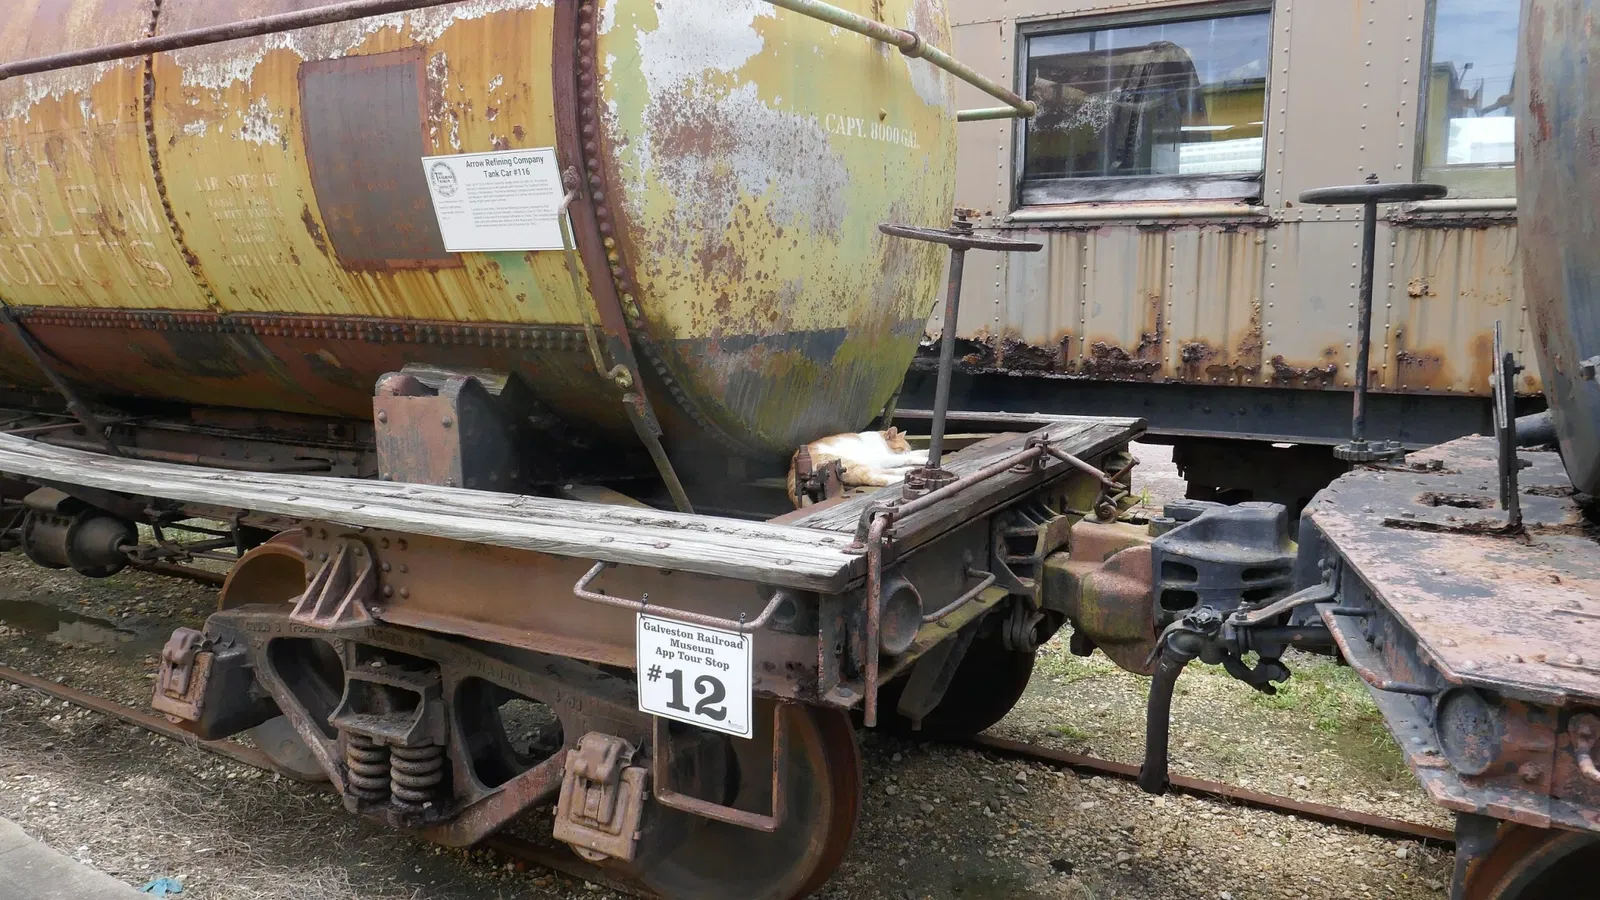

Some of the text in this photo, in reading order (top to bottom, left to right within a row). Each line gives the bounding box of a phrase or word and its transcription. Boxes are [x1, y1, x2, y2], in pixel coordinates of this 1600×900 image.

[870, 122, 900, 144] 8000
[465, 155, 544, 168] Arrow Refining Company
[483, 167, 531, 178] Tank Car #116
[643, 621, 744, 650] Galveston Railroad
[669, 638, 714, 655] Museum
[655, 646, 730, 672] App Tour Stop
[646, 664, 728, 722] #12
